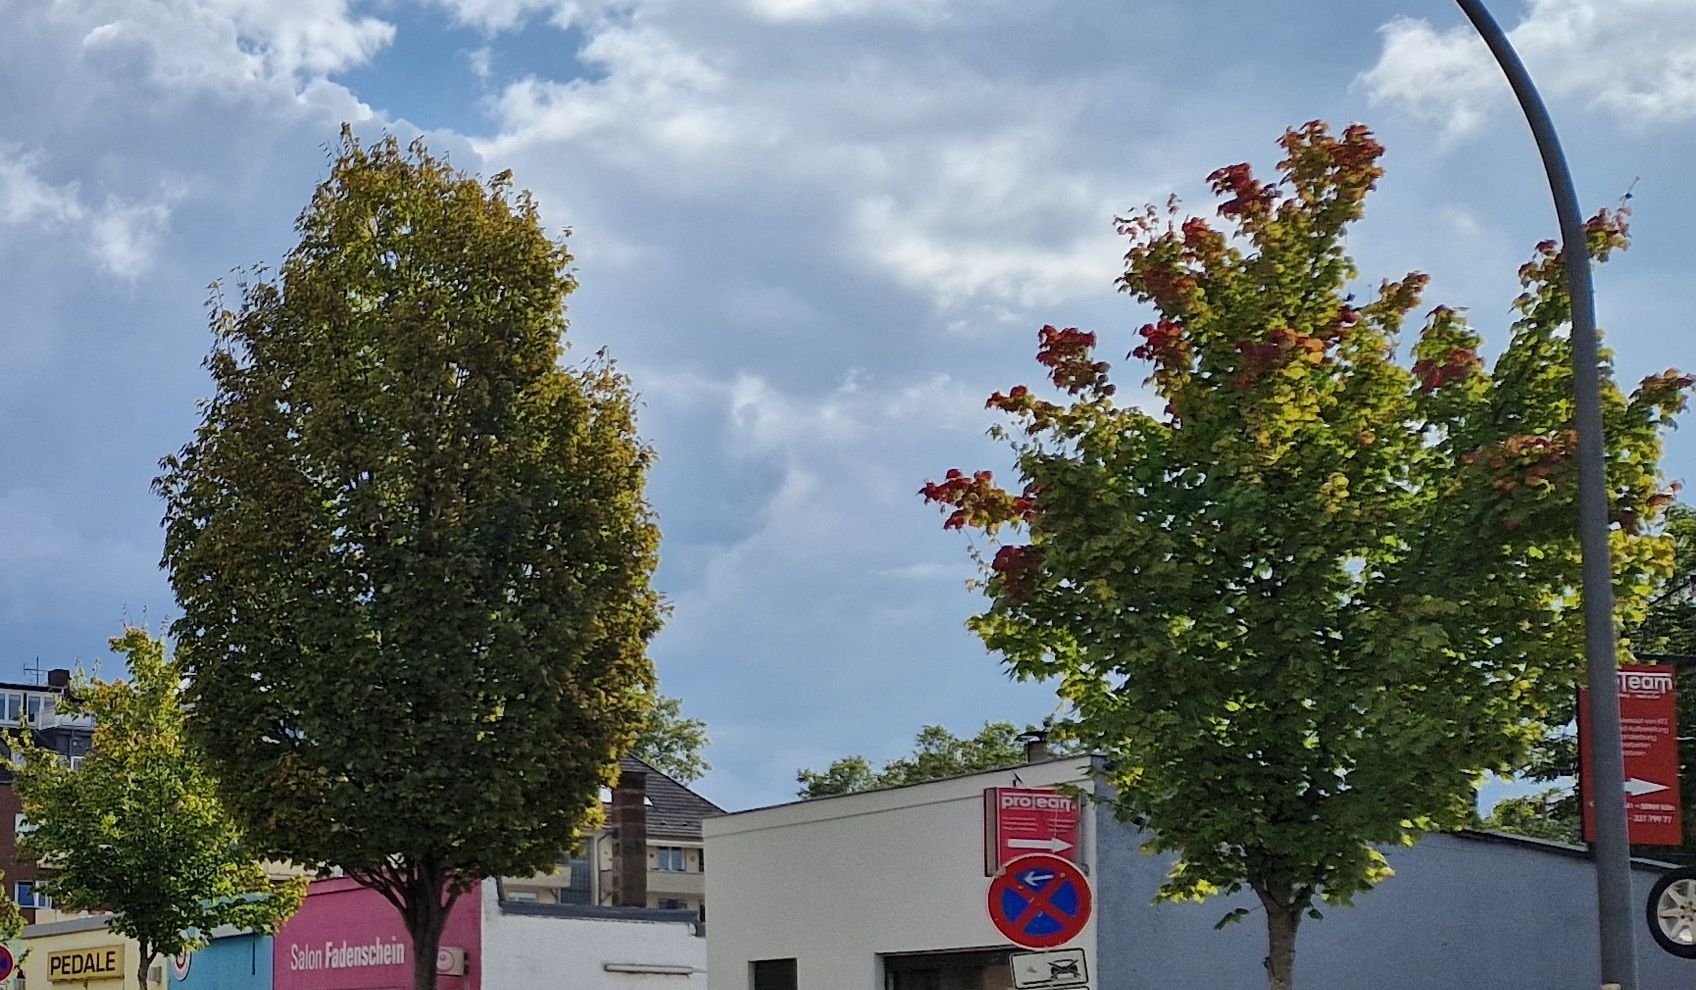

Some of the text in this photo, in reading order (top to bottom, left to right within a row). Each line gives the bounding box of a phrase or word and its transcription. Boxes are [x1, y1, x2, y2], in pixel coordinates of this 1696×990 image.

[50, 950, 116, 976] PEDALE
[290, 935, 405, 971] Salon Fadenschein
